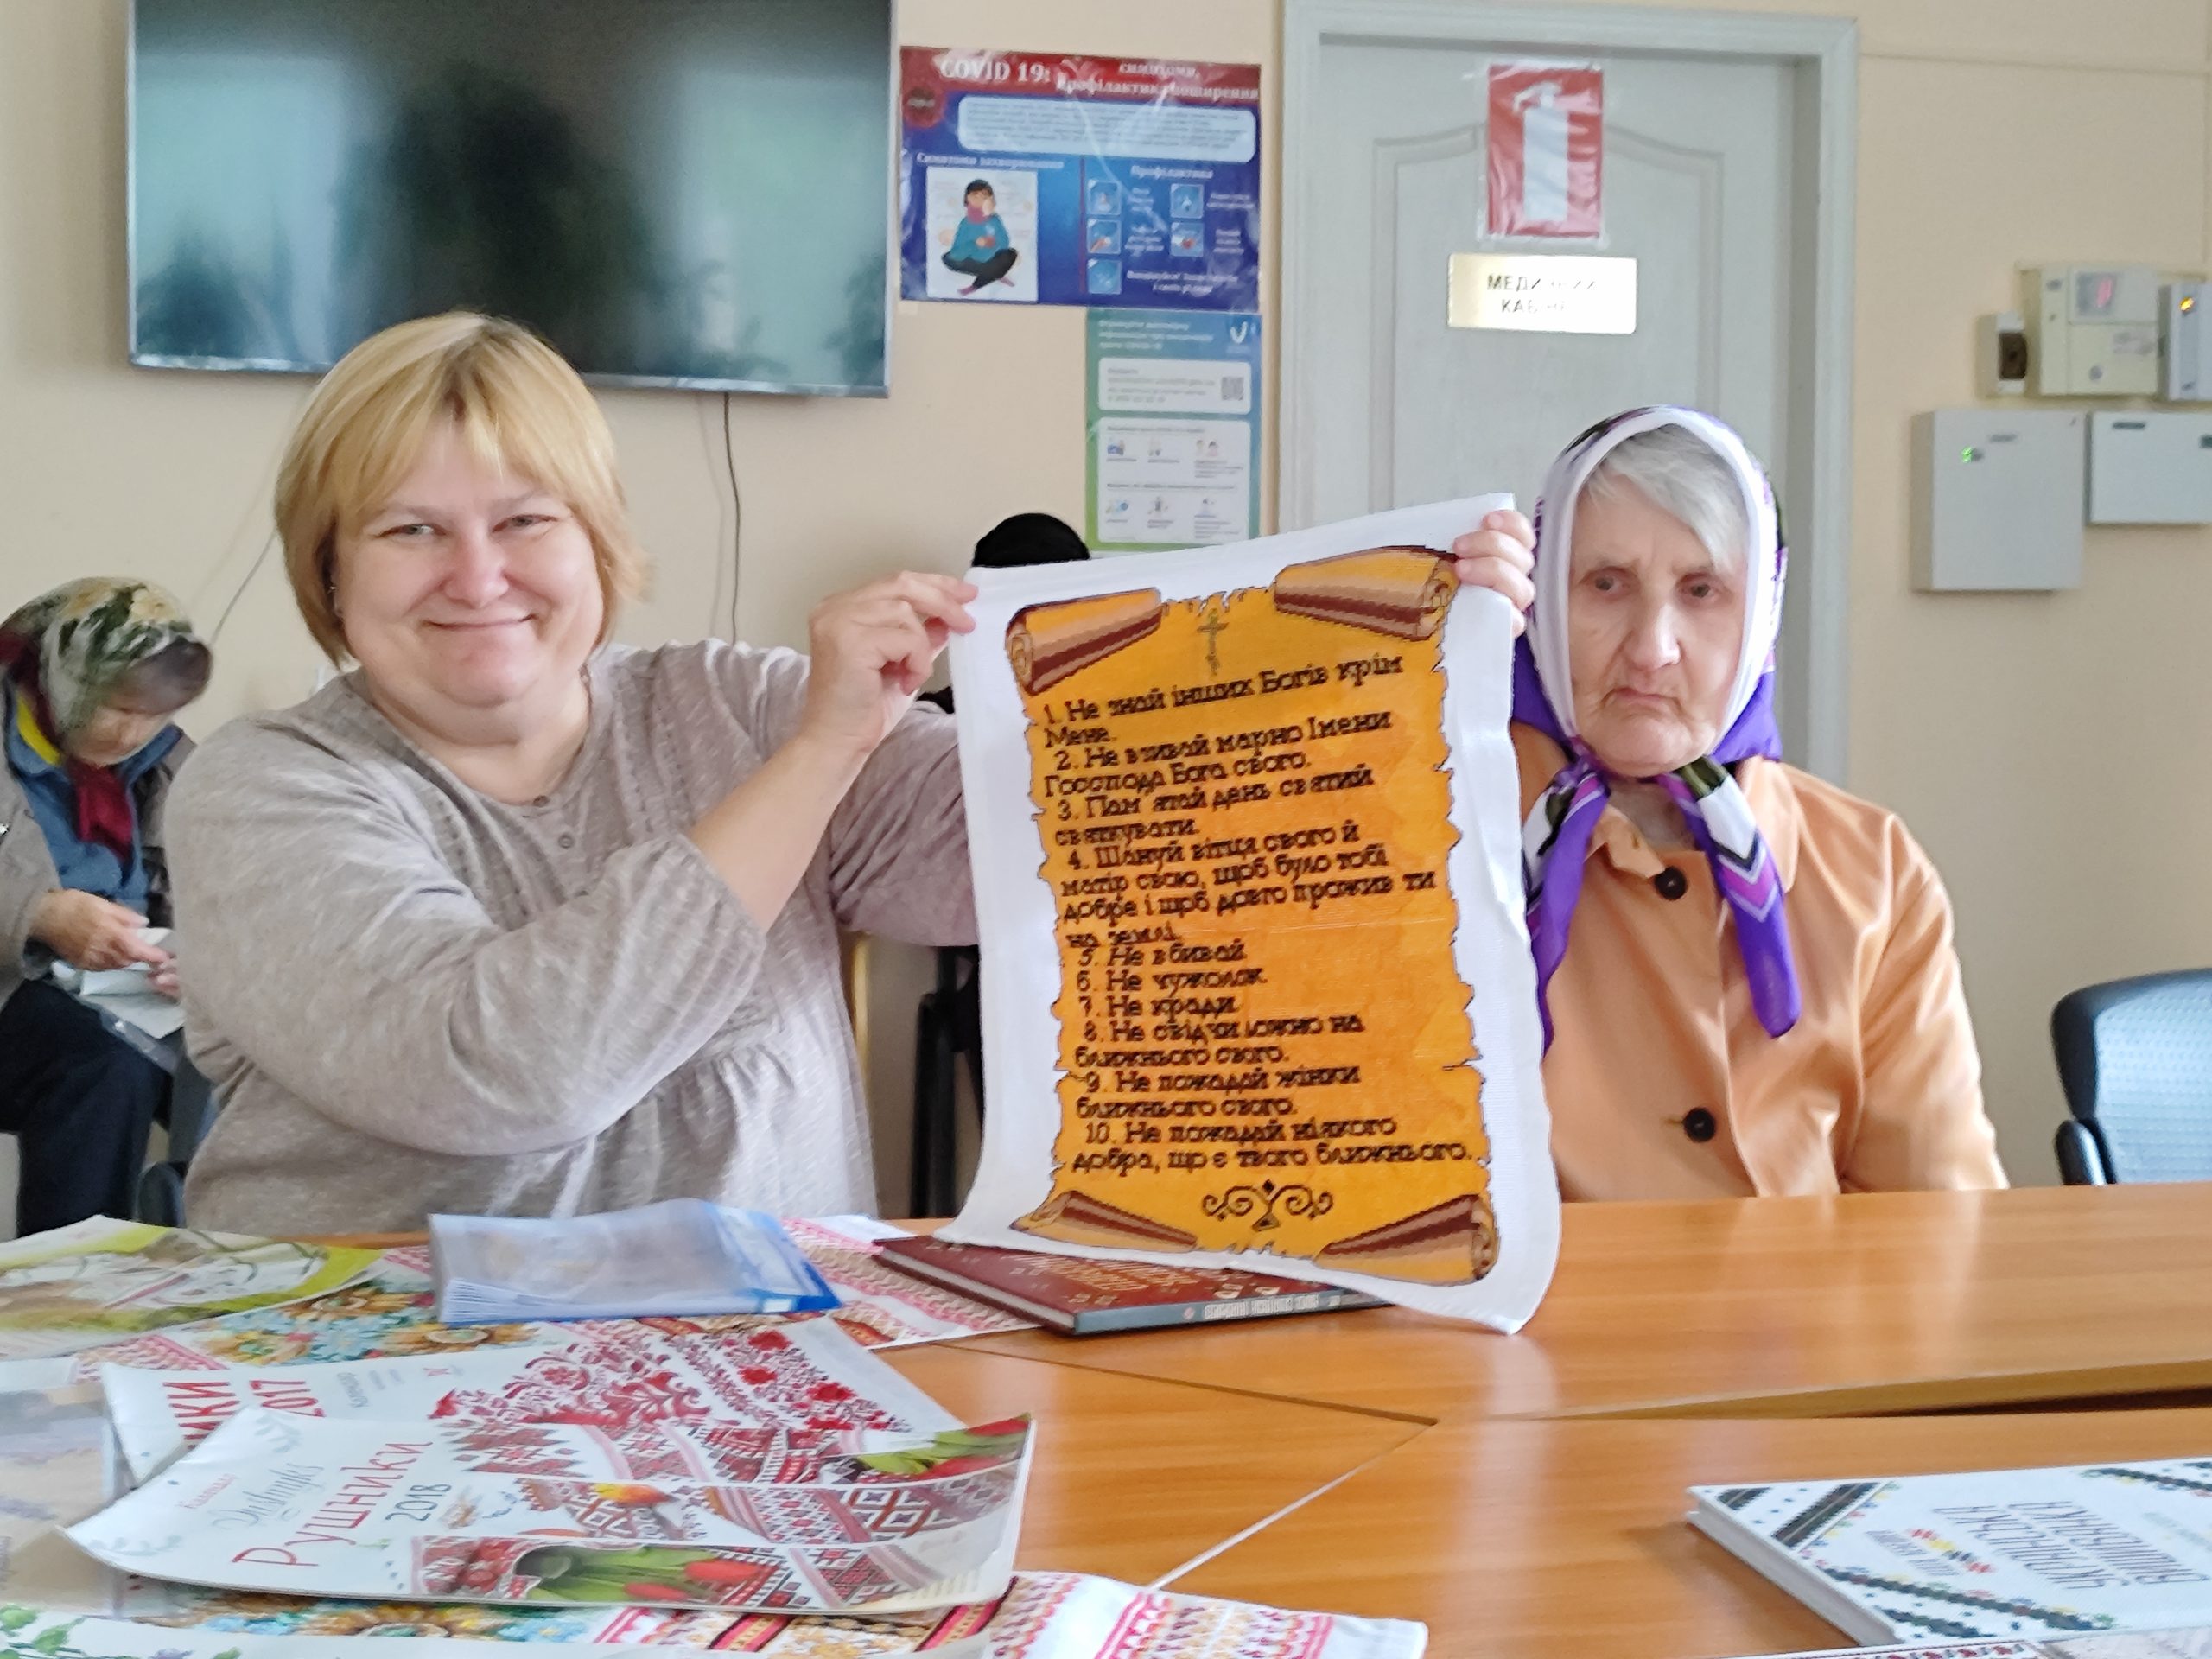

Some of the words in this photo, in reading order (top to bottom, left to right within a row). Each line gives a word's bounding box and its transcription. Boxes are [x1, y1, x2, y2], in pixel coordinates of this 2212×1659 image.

[939, 59, 1011, 83] COVID
[1065, 698, 1100, 722] Не
[1108, 687, 1166, 717] знай
[1172, 678, 1255, 708] інших
[1258, 663, 1329, 694] Богів
[1336, 652, 1403, 687] крім
[1054, 749, 1078, 771] 2.
[1084, 746, 1120, 769] Не
[1216, 725, 1303, 757] марно
[1307, 711, 1393, 741] Імени
[1169, 761, 1227, 785] Бога
[1233, 751, 1312, 777] свого.
[1058, 798, 1079, 821] 3.
[1212, 783, 1271, 812] день
[1068, 848, 1090, 870] 4.
[1094, 839, 1185, 873] Шануй
[1263, 826, 1336, 853] свого
[1341, 818, 1360, 842] й
[1060, 871, 1128, 901] матір
[1213, 855, 1269, 887] щоб
[1274, 853, 1332, 883] було
[1064, 897, 1138, 927] добре
[1144, 893, 1154, 915] і
[1158, 890, 1211, 919] щоб
[1217, 885, 1288, 916] довго
[1293, 874, 1395, 910] прожив
[1402, 869, 1437, 892] ти
[1065, 932, 1101, 949] на
[1078, 947, 1099, 967] 5.
[1107, 945, 1144, 966] Не
[1077, 969, 1097, 992] 6.
[1106, 969, 1142, 991] Не
[1079, 995, 1101, 1017] 7.
[1105, 995, 1142, 1018] Не
[1084, 1020, 1105, 1043] 8.
[1109, 1020, 1145, 1042] Не
[1328, 1014, 1366, 1033] на
[1074, 1045, 1211, 1067] ближнього
[1215, 1045, 1290, 1065] свого.
[1085, 1071, 1109, 1094] 9.
[1115, 1070, 1151, 1093] Не
[1158, 1066, 1269, 1096] пожадай
[1077, 1096, 1217, 1120] ближнього
[1220, 1096, 1297, 1116] свого.
[1085, 1122, 1116, 1145] 10.
[1124, 1121, 1162, 1144] Не
[1168, 1117, 1287, 1147] пожадай
[1071, 1147, 1160, 1177] добра,
[1167, 1150, 1208, 1174] що
[1235, 1148, 1308, 1168] твого
[1315, 1141, 1472, 1166] ближнього.
[231, 1441, 435, 1568] Рушники
[385, 1482, 453, 1522] 2018
